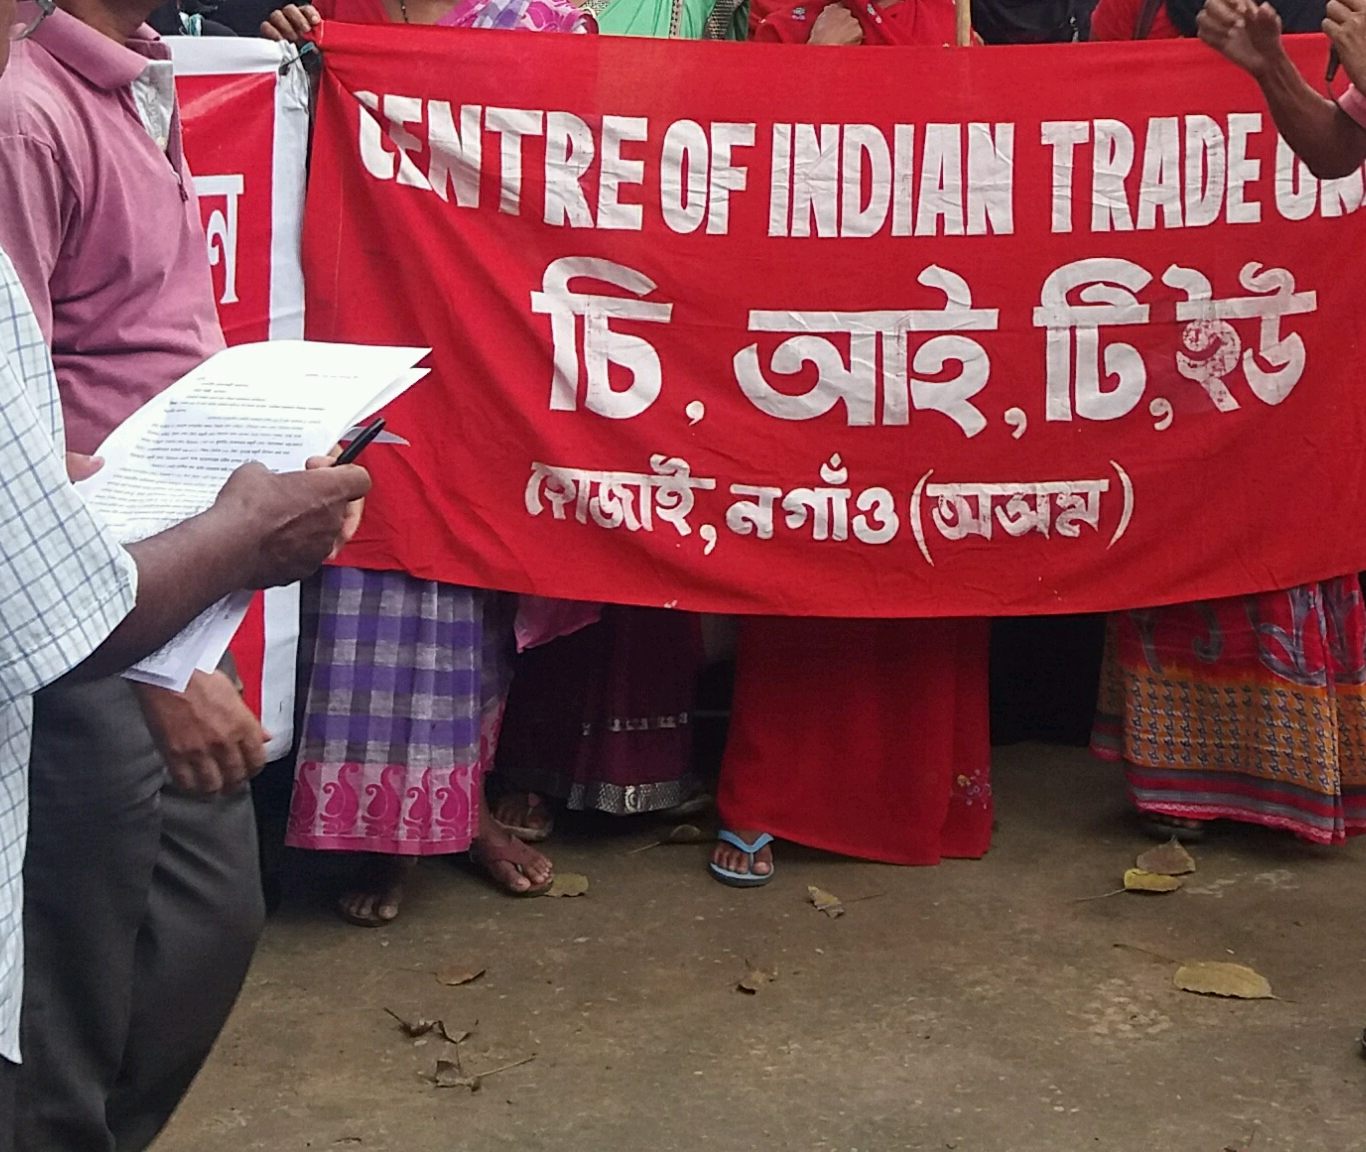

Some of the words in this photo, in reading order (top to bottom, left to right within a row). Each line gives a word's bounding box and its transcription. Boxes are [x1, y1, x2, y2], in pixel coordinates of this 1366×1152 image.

[354, 91, 648, 230] CENTRE
[661, 120, 756, 234] OF
[768, 122, 1014, 237] INDIAN
[1041, 113, 1262, 233] TRADE
